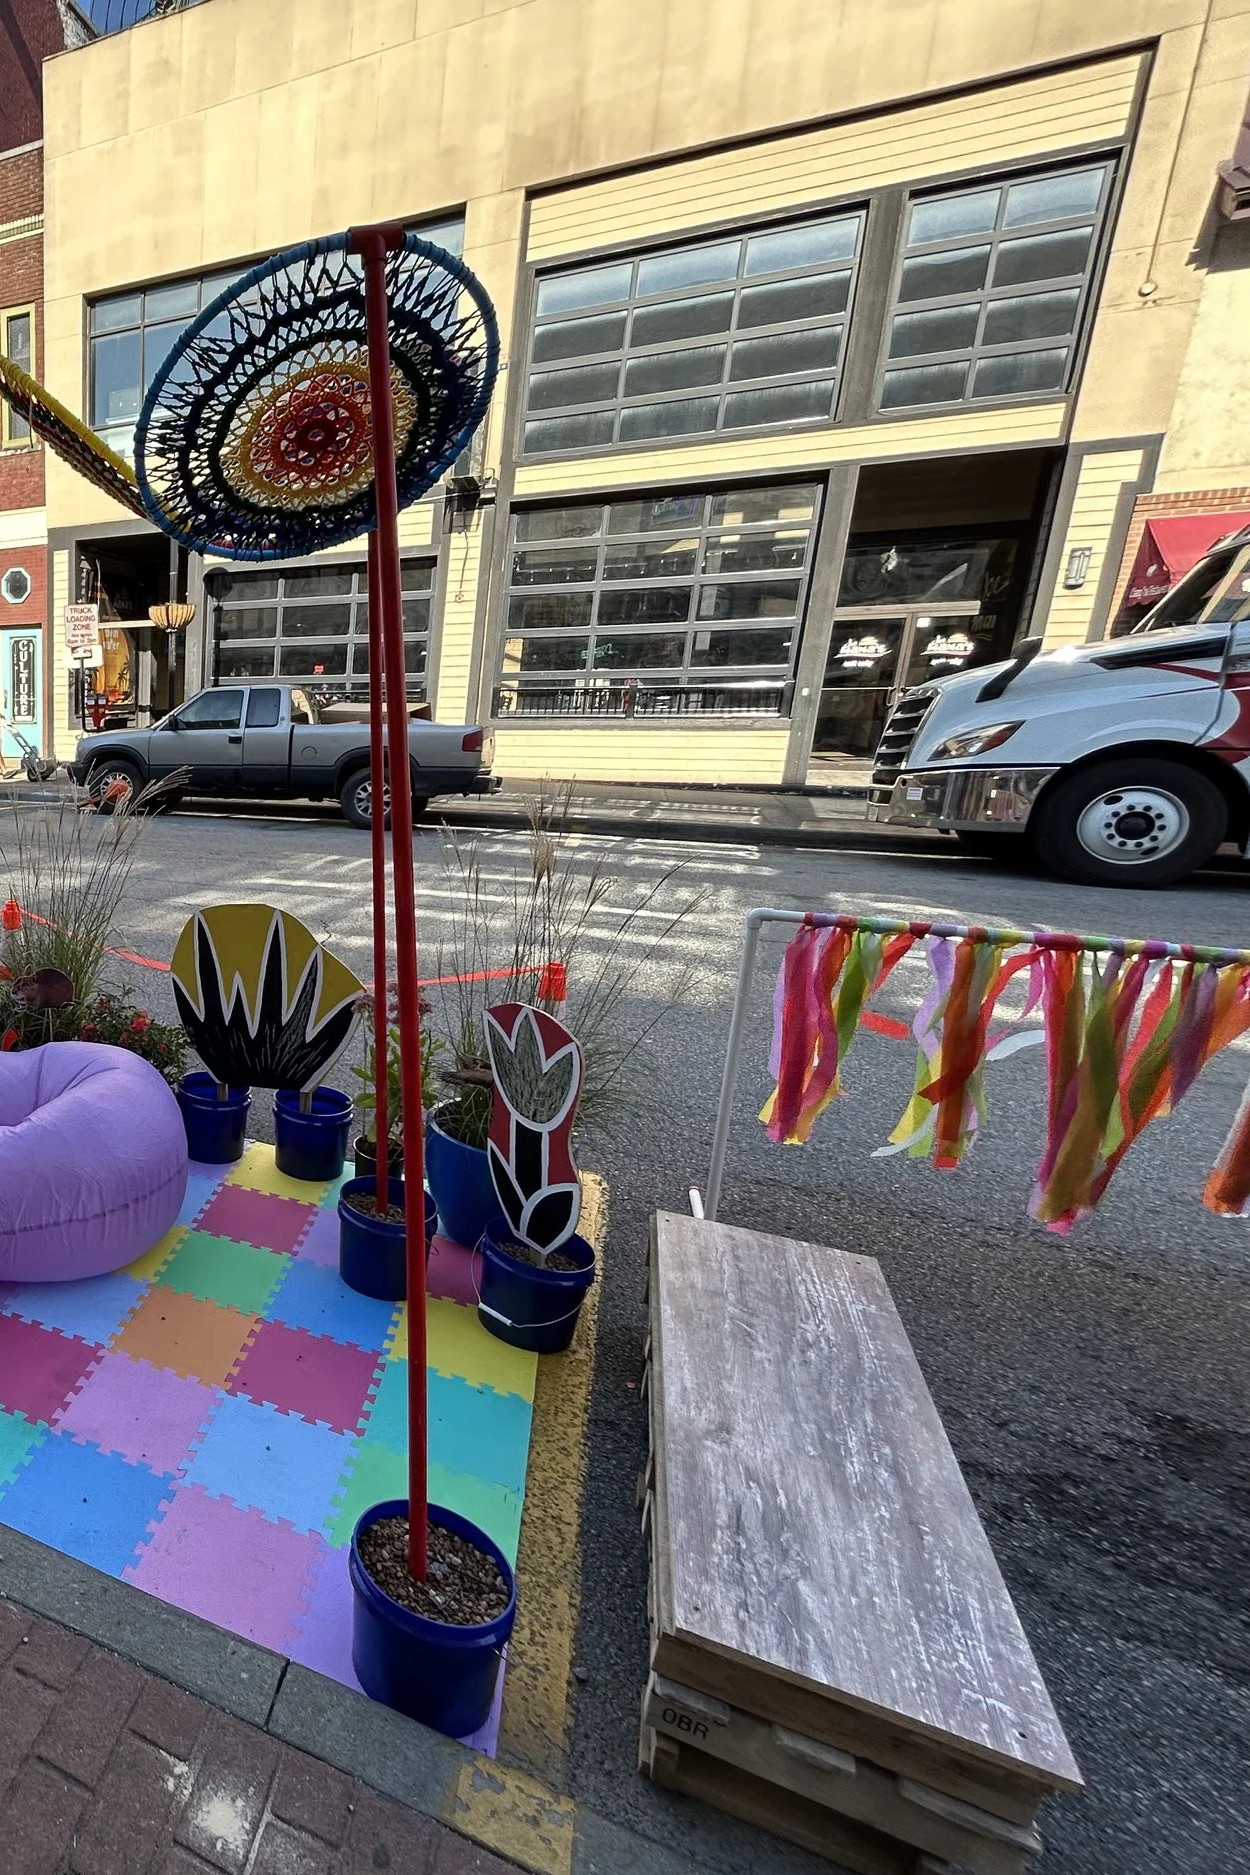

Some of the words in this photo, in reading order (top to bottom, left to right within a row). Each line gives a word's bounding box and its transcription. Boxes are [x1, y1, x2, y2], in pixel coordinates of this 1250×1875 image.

[70, 607, 93, 615] TRUCK
[66, 615, 96, 623] LOADING
[72, 623, 91, 631] ZONE
[18, 640, 29, 716] CULTURE
